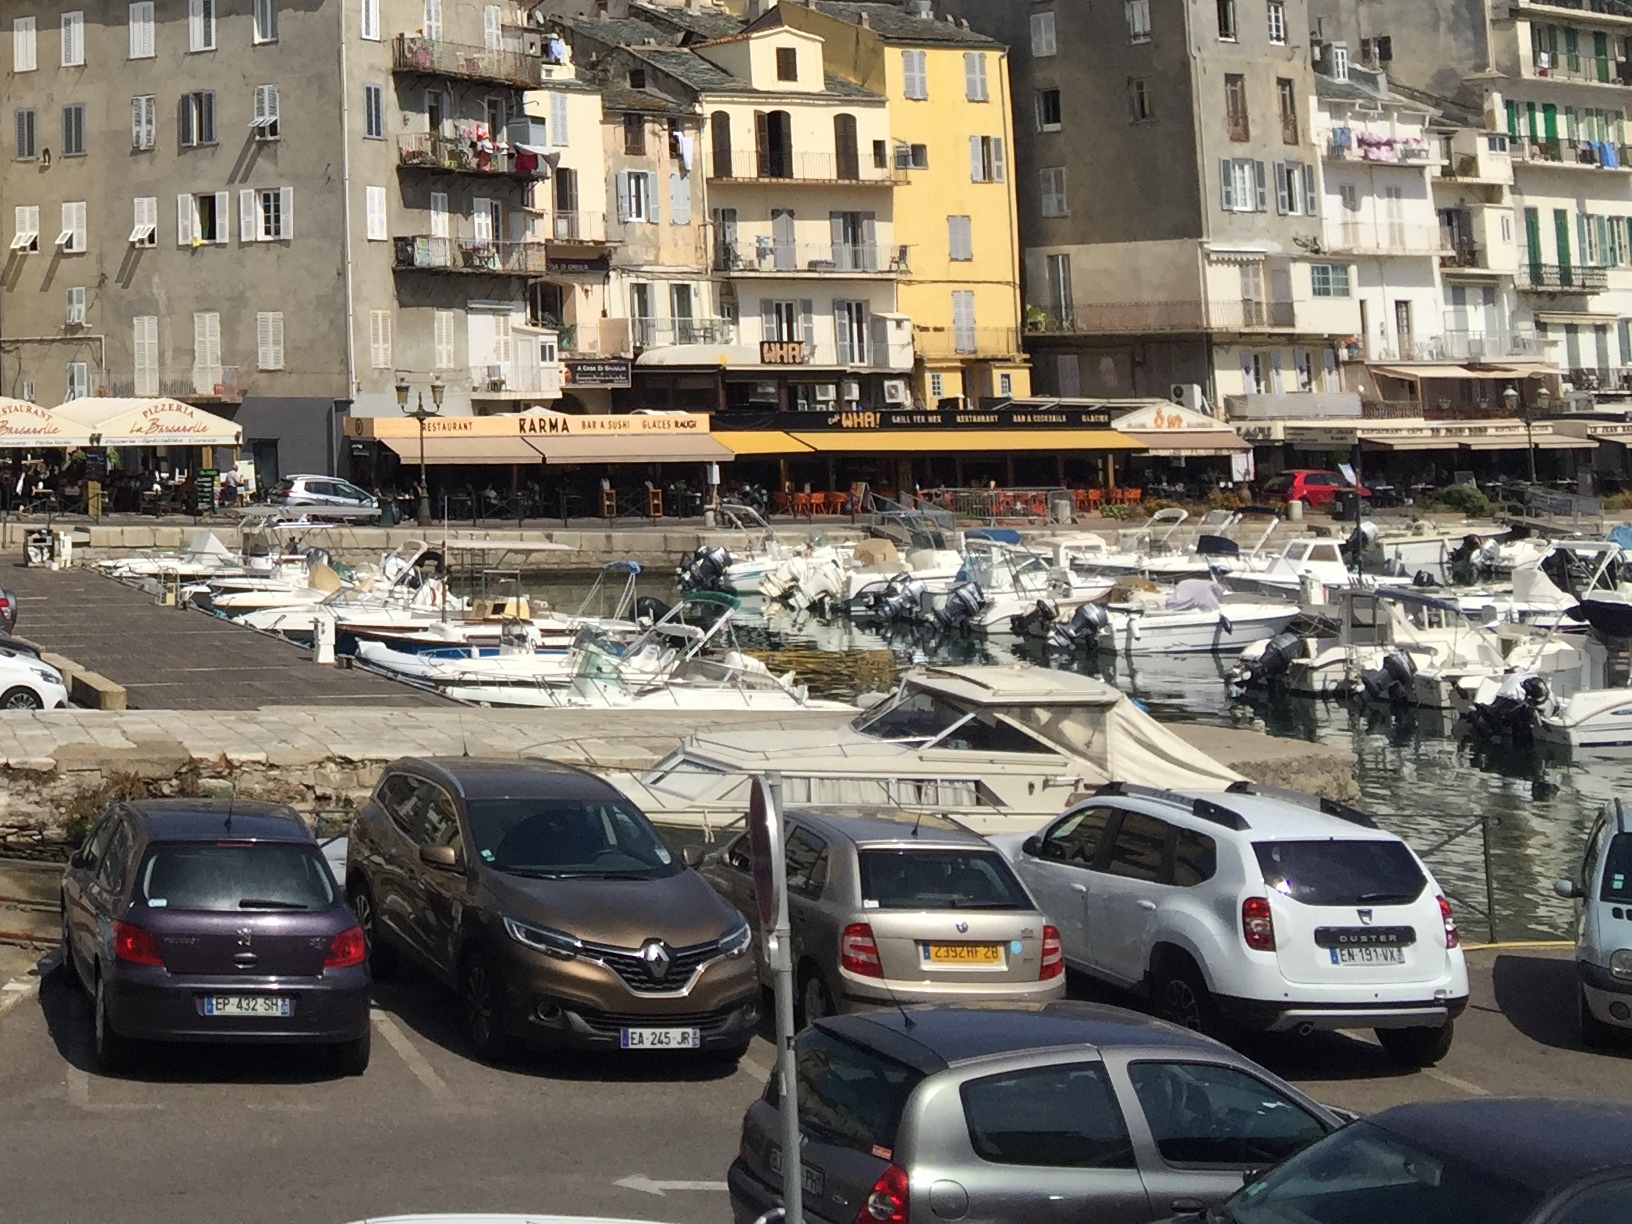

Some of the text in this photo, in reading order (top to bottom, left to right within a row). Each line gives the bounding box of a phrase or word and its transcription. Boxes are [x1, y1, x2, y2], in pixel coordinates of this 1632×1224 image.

[142, 403, 195, 419] PIZZERIA
[422, 417, 570, 434] RESTAURANT KARMA
[581, 420, 597, 430] BAR
[608, 419, 630, 430] SUSHI
[642, 419, 672, 429] GLACES
[841, 412, 881, 429] WHA!
[956, 414, 999, 423] RESTAURANT
[1012, 414, 1026, 423] BAR
[1081, 414, 1109, 423] GLACIER
[1339, 935, 1397, 943] DUSTER
